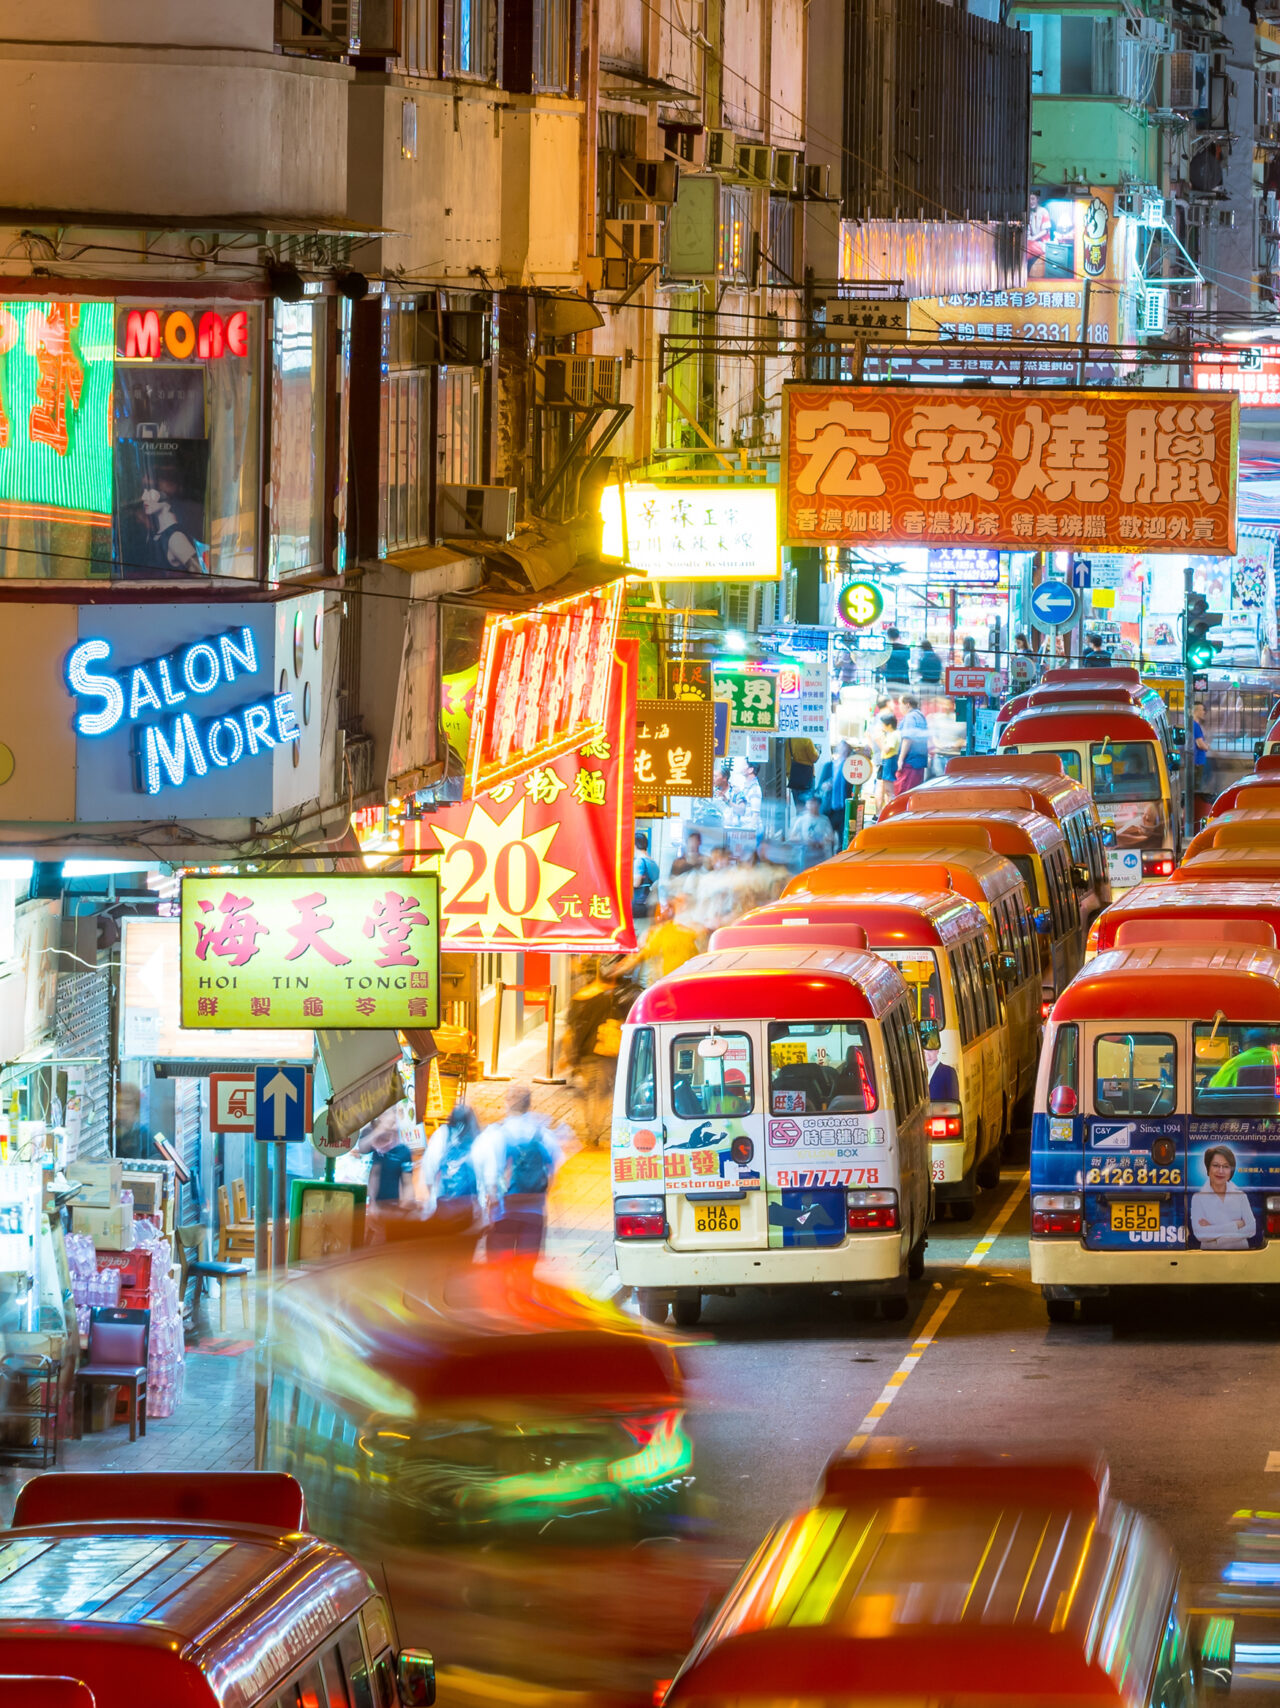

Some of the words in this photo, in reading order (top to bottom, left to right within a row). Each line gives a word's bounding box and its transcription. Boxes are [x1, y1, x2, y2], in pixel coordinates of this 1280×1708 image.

[125, 310, 248, 359] MORE
[796, 508, 892, 533] 香濃咖啡
[904, 511, 1000, 537] 香濃奶茶
[1119, 516, 1215, 542] 歡迎外賣
[69, 627, 258, 735] SALON
[149, 692, 300, 795] MORE
[443, 839, 542, 917] 20
[557, 894, 612, 920] 元起
[194, 890, 430, 968] 海天堂
[199, 976, 238, 989] HOI
[272, 976, 309, 989] TIN
[345, 976, 408, 989] TONG
[197, 996, 429, 1017] 鮮製龜苓膏
[817, 1047, 826, 1058] 10
[803, 1119, 816, 1128] SC
[1140, 1123, 1160, 1133] Since
[1163, 1124, 1181, 1133] 1994
[837, 1148, 858, 1157] BOX
[613, 1150, 719, 1183] 重新出發
[1089, 1168, 1134, 1184] 8126
[1137, 1168, 1181, 1184] 8126
[707, 1206, 727, 1218] HA
[697, 1218, 738, 1231] 8060
[1113, 1217, 1157, 1229] 3620
